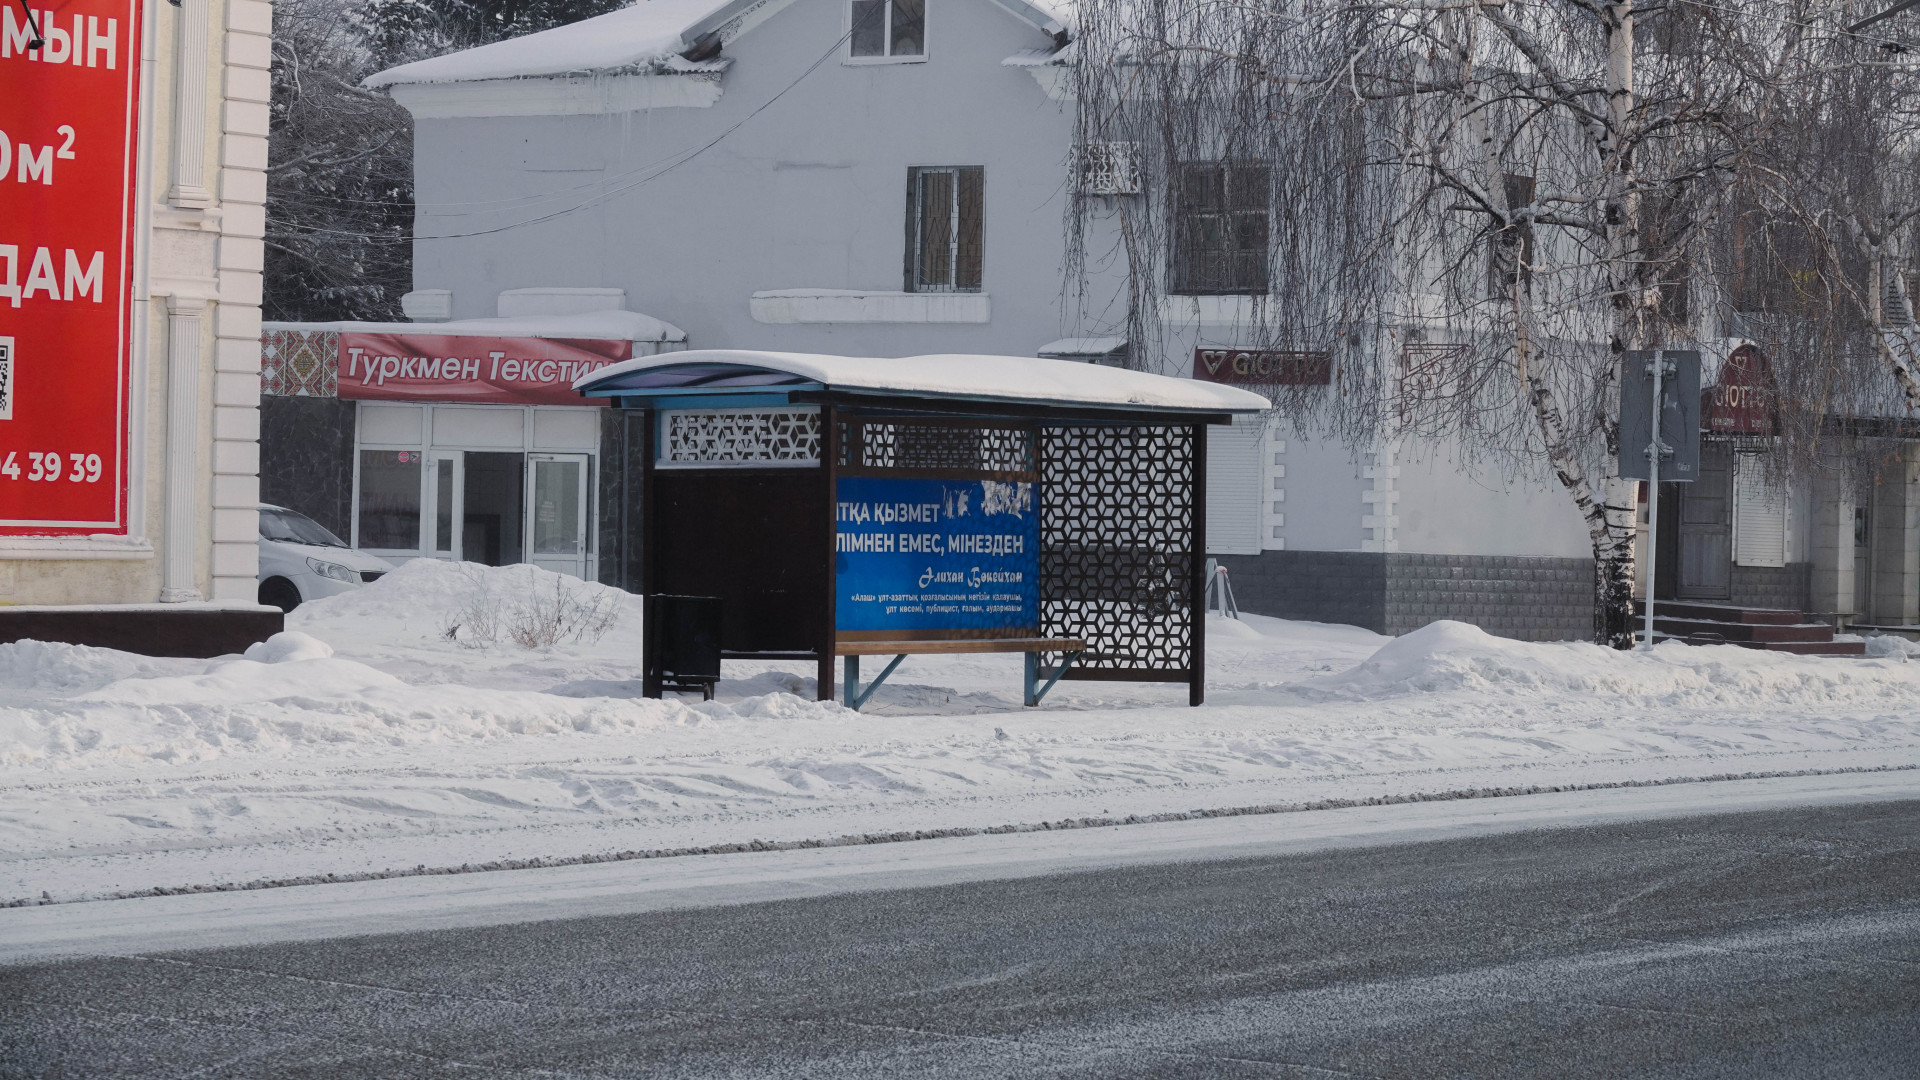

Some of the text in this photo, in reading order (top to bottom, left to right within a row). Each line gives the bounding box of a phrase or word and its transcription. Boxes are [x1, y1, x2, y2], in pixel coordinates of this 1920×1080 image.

[2, 5, 118, 70] МЫН
[347, 347, 616, 386] Туркмен Тексти
[27, 451, 62, 482] 39
[69, 453, 102, 483] 39
[874, 502, 940, 525] ҚЫЗМЕТ
[899, 533, 945, 557] ЕМЕС,
[948, 534, 1024, 557] МІНЕЗДЕН
[918, 566, 1023, 589] Әлихан Бөкейхан
[851, 592, 876, 602] «Алаш»
